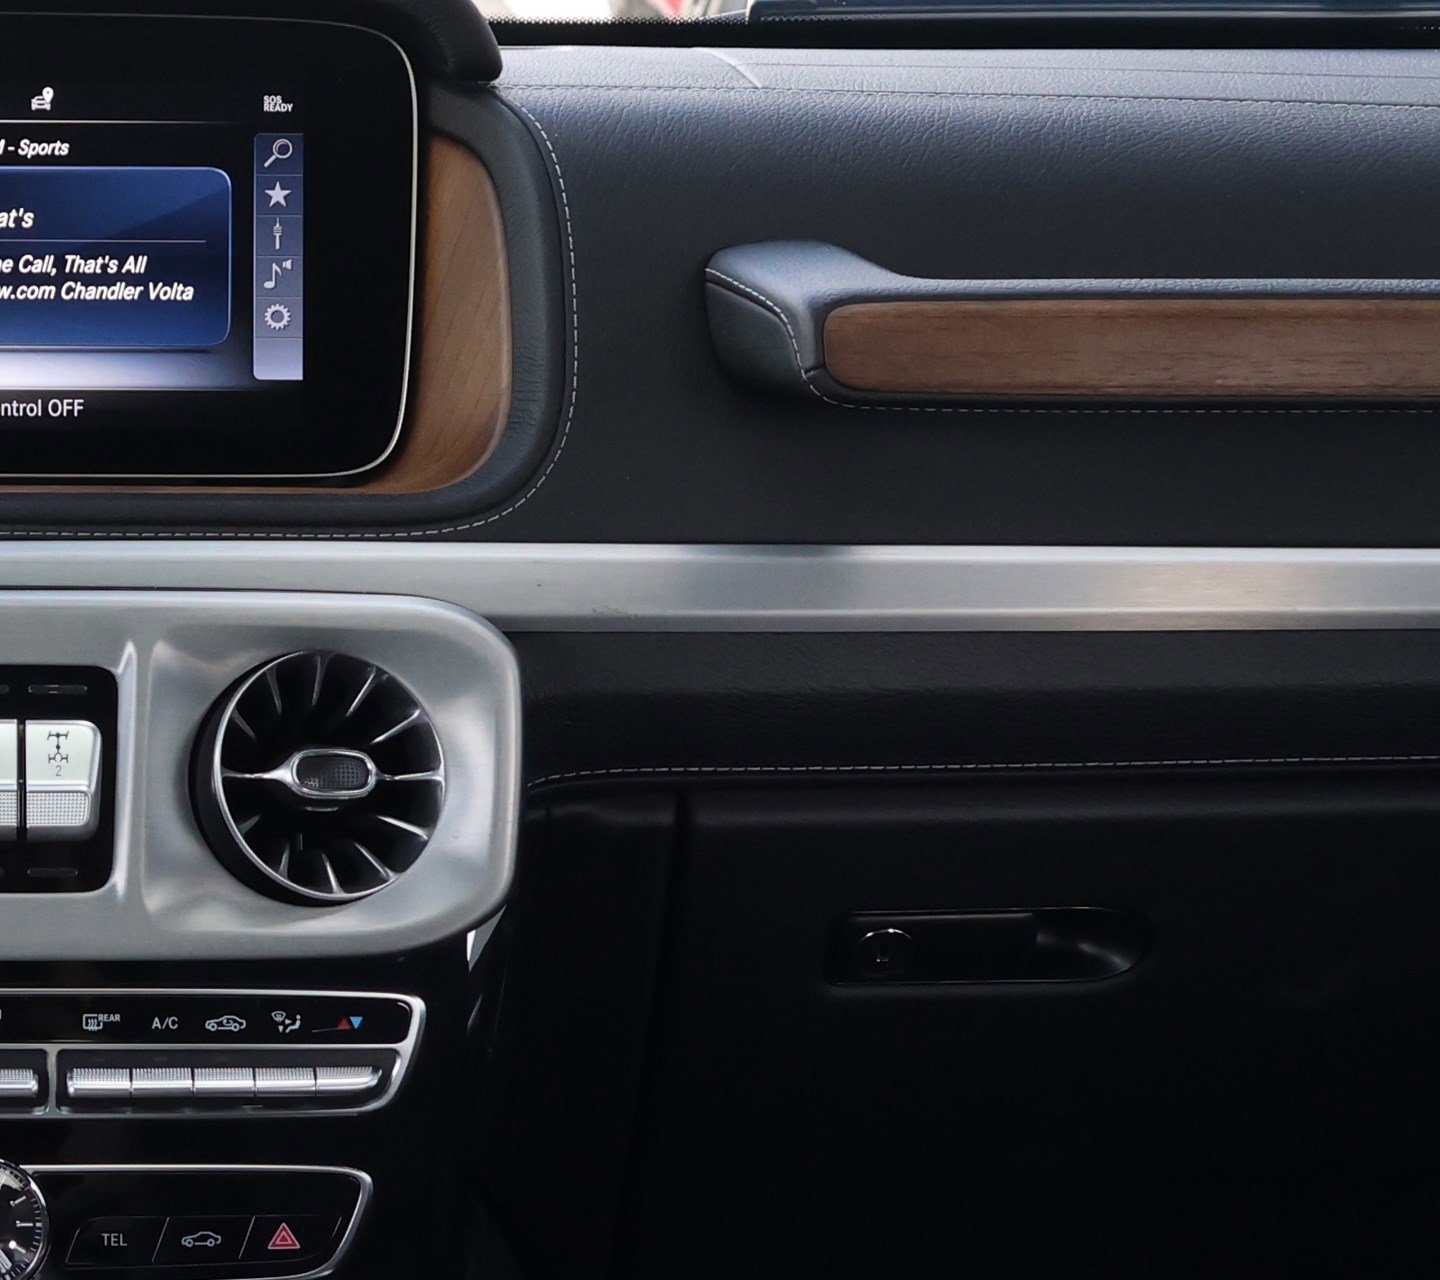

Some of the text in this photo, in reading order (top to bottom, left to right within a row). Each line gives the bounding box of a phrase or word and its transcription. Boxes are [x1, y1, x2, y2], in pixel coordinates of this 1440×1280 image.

[263, 95, 282, 104] SOS
[263, 103, 293, 112] READY
[17, 139, 70, 159] Sports
[18, 254, 57, 276] Call,
[63, 255, 118, 273] That's
[121, 256, 148, 273] All
[60, 281, 144, 301] Chandler
[148, 282, 195, 301] Volta
[48, 399, 85, 417] OFF
[55, 765, 63, 777] 2
[98, 1014, 121, 1022] REAR
[151, 1016, 179, 1030] A/C
[101, 1233, 128, 1247] TEL
